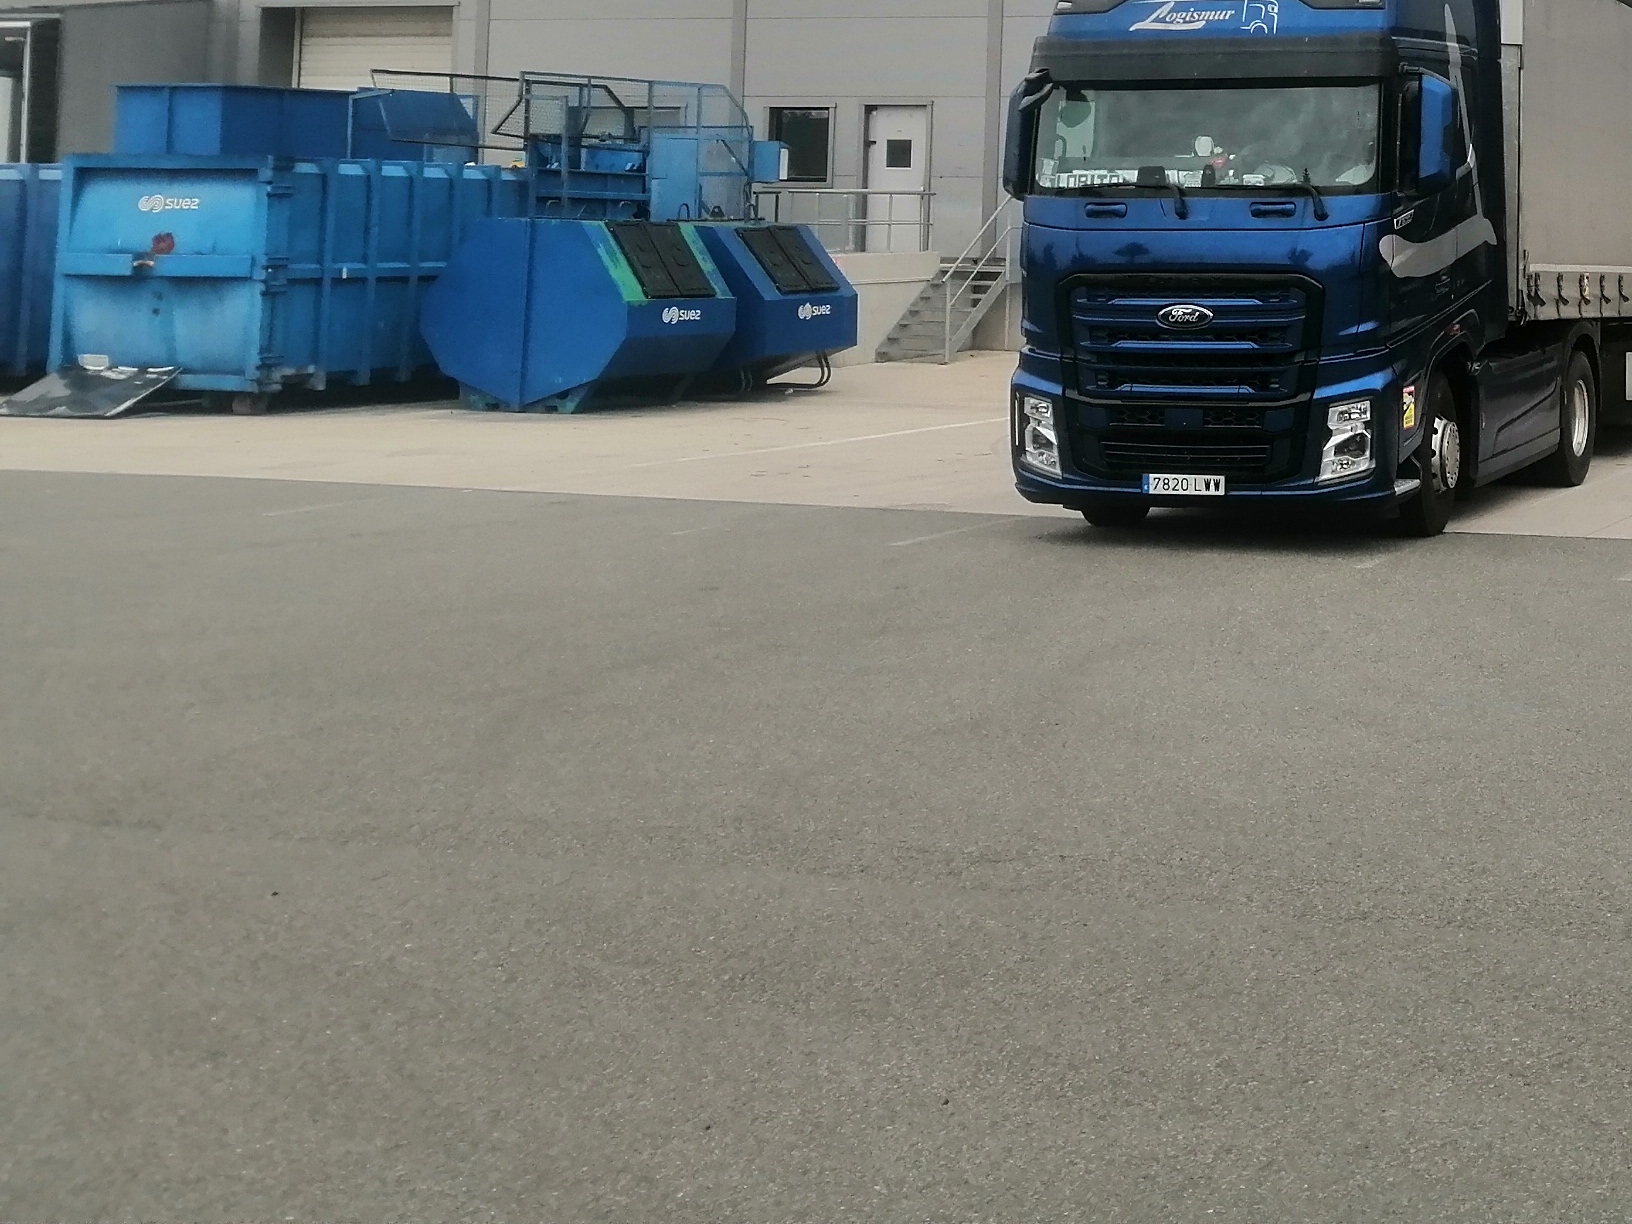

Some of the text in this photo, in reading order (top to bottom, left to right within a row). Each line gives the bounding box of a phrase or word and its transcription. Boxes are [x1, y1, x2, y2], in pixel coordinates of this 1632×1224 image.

[1128, 0, 1236, 32] Logismur
[164, 197, 200, 210] suez
[679, 309, 701, 321] suez
[1168, 308, 1200, 322] Ford
[1153, 477, 1221, 492] 7820 LWW
